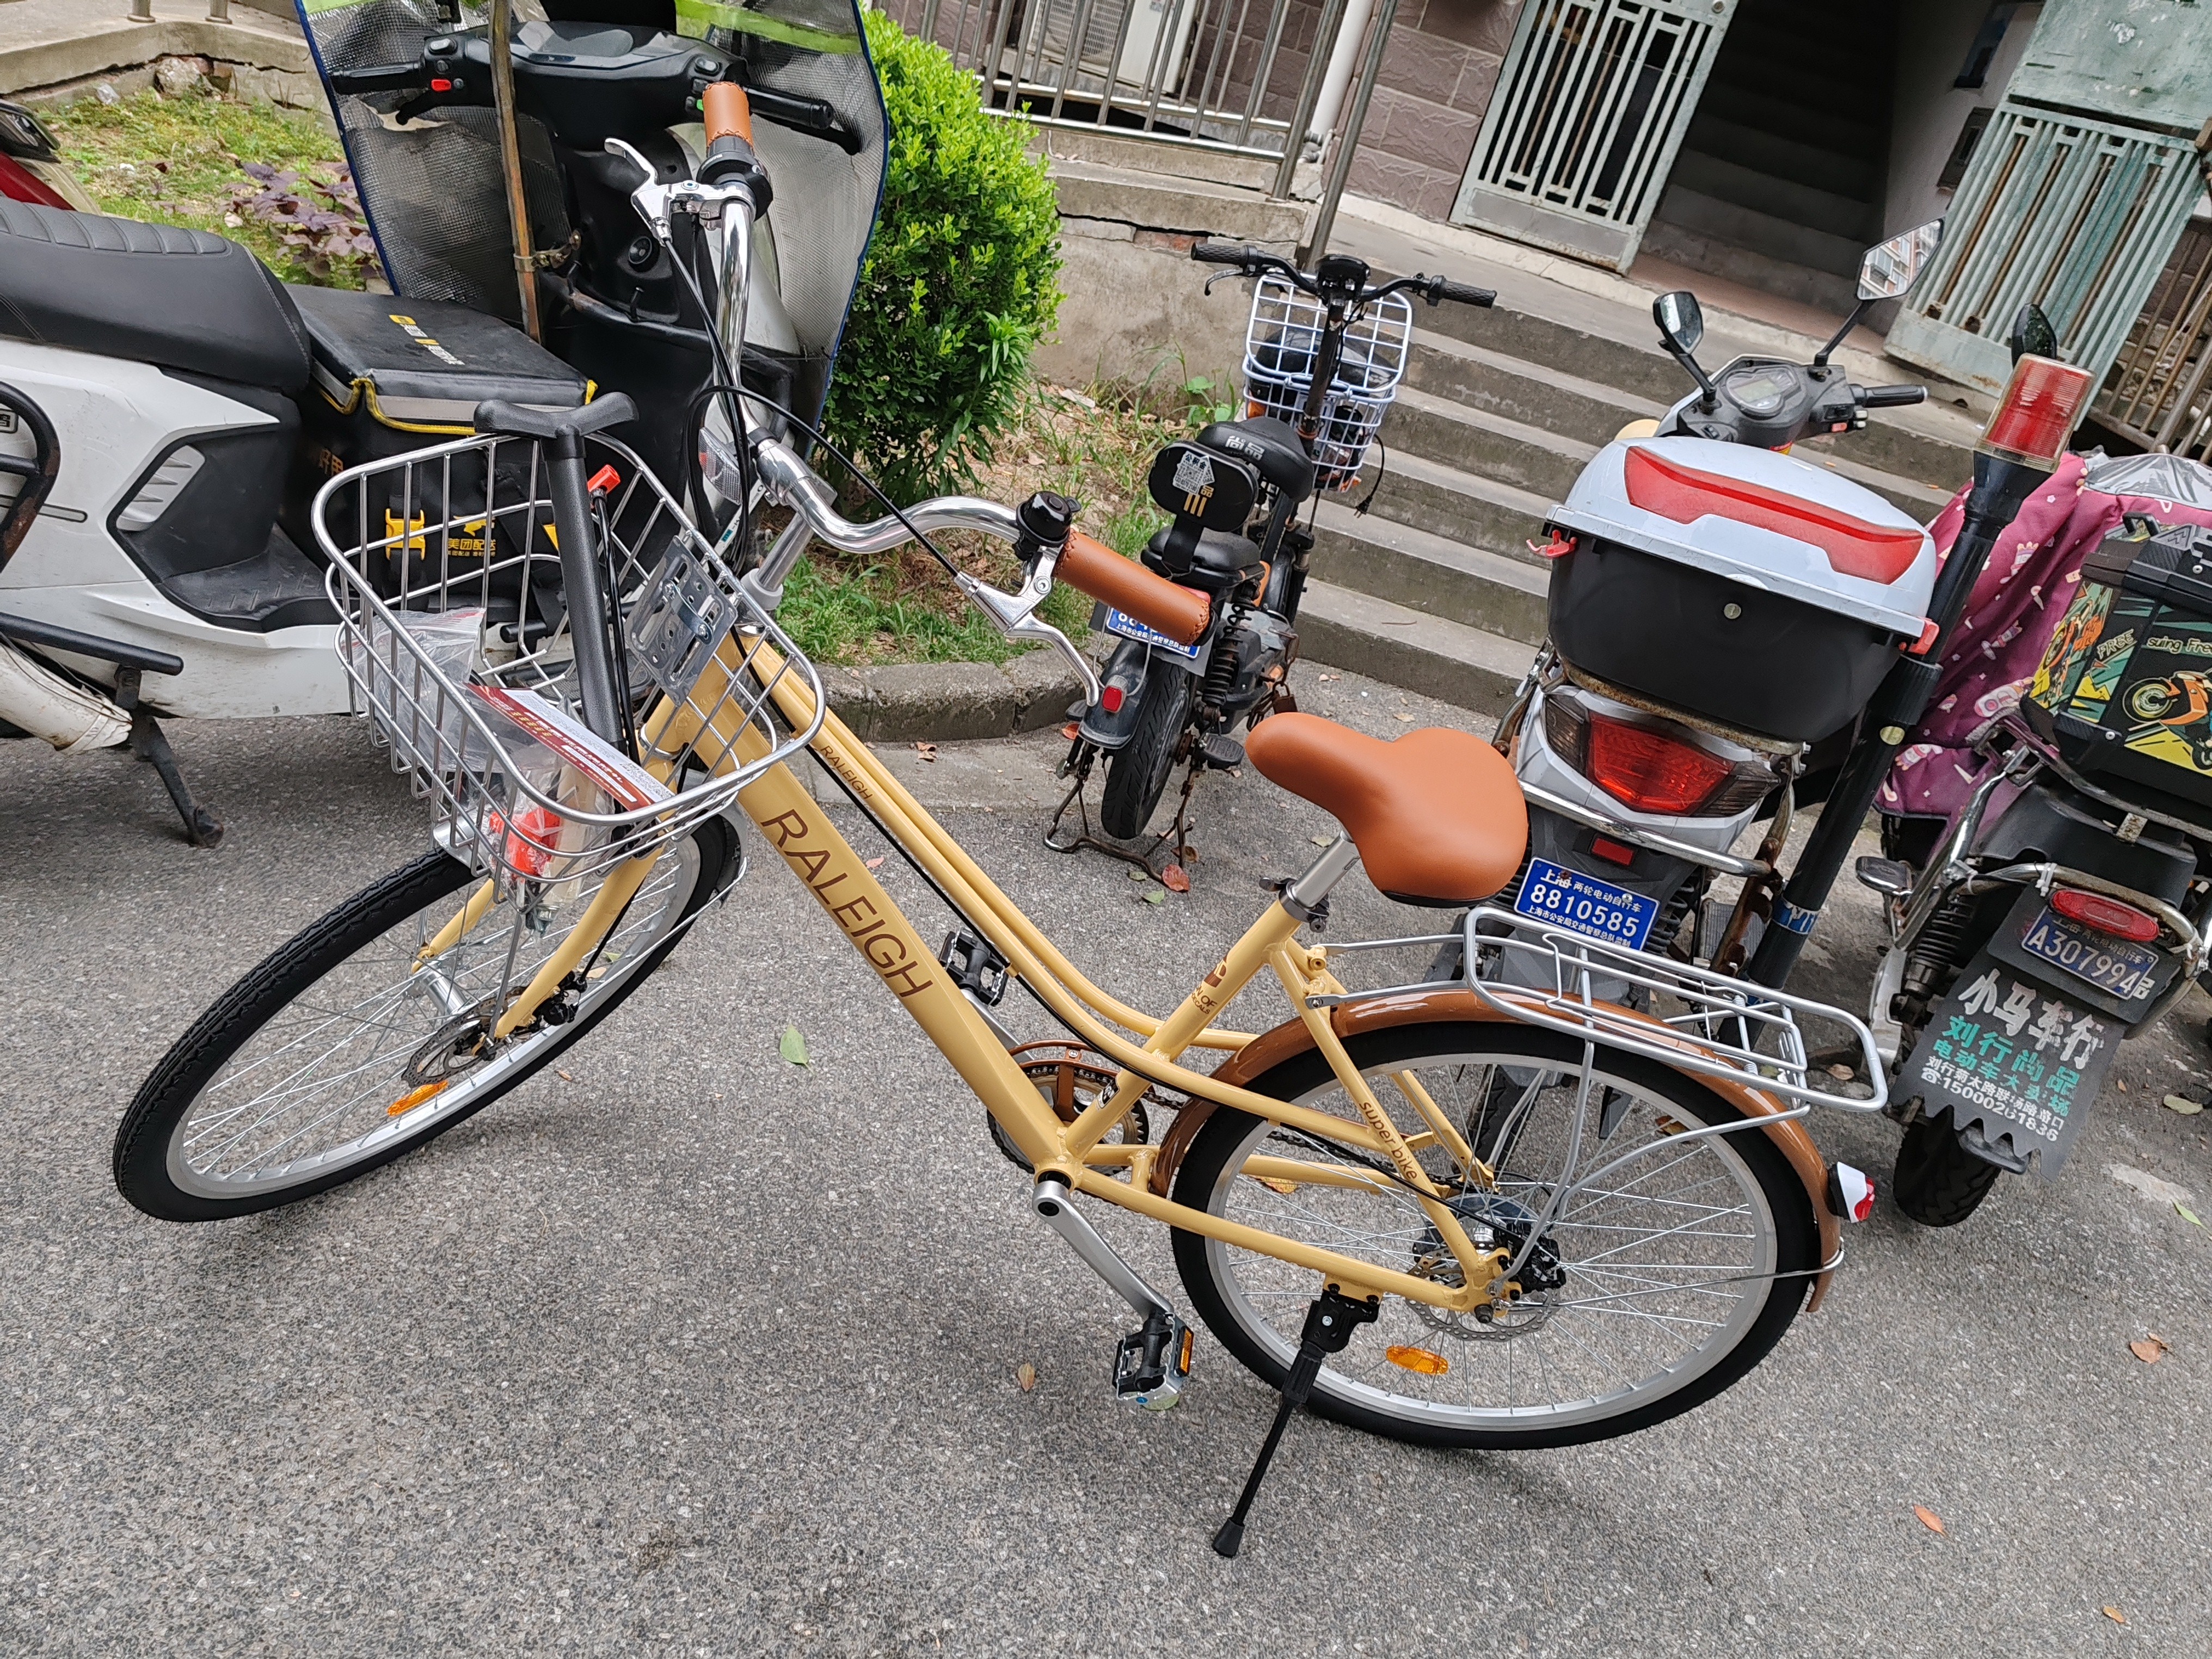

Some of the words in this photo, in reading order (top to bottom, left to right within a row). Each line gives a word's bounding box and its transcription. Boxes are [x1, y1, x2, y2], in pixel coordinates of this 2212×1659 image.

[1225, 435, 1265, 461] 尚品
[447, 538, 496, 551] 美团配送
[1116, 623, 1190, 653] 上海市公安局通警察总队监制
[2097, 628, 2134, 660] FREE
[2185, 637, 2212, 655] Fre
[820, 745, 873, 800] RALEIGH
[760, 808, 933, 998] RALEIGH
[1530, 883, 1640, 938] 8810585
[1540, 868, 1572, 889] 上海
[1573, 881, 1643, 913] 两轮电动自行车
[1526, 904, 1632, 948] 上海市公安局交通警察总队监制
[2027, 925, 2141, 994] A307994
[1201, 995, 1218, 1007] OF
[1958, 968, 2105, 1070] 小马车行
[1941, 1015, 2081, 1099] 刘行尚品
[1359, 1102, 1397, 1144] super
[1391, 1145, 1418, 1180] bike
